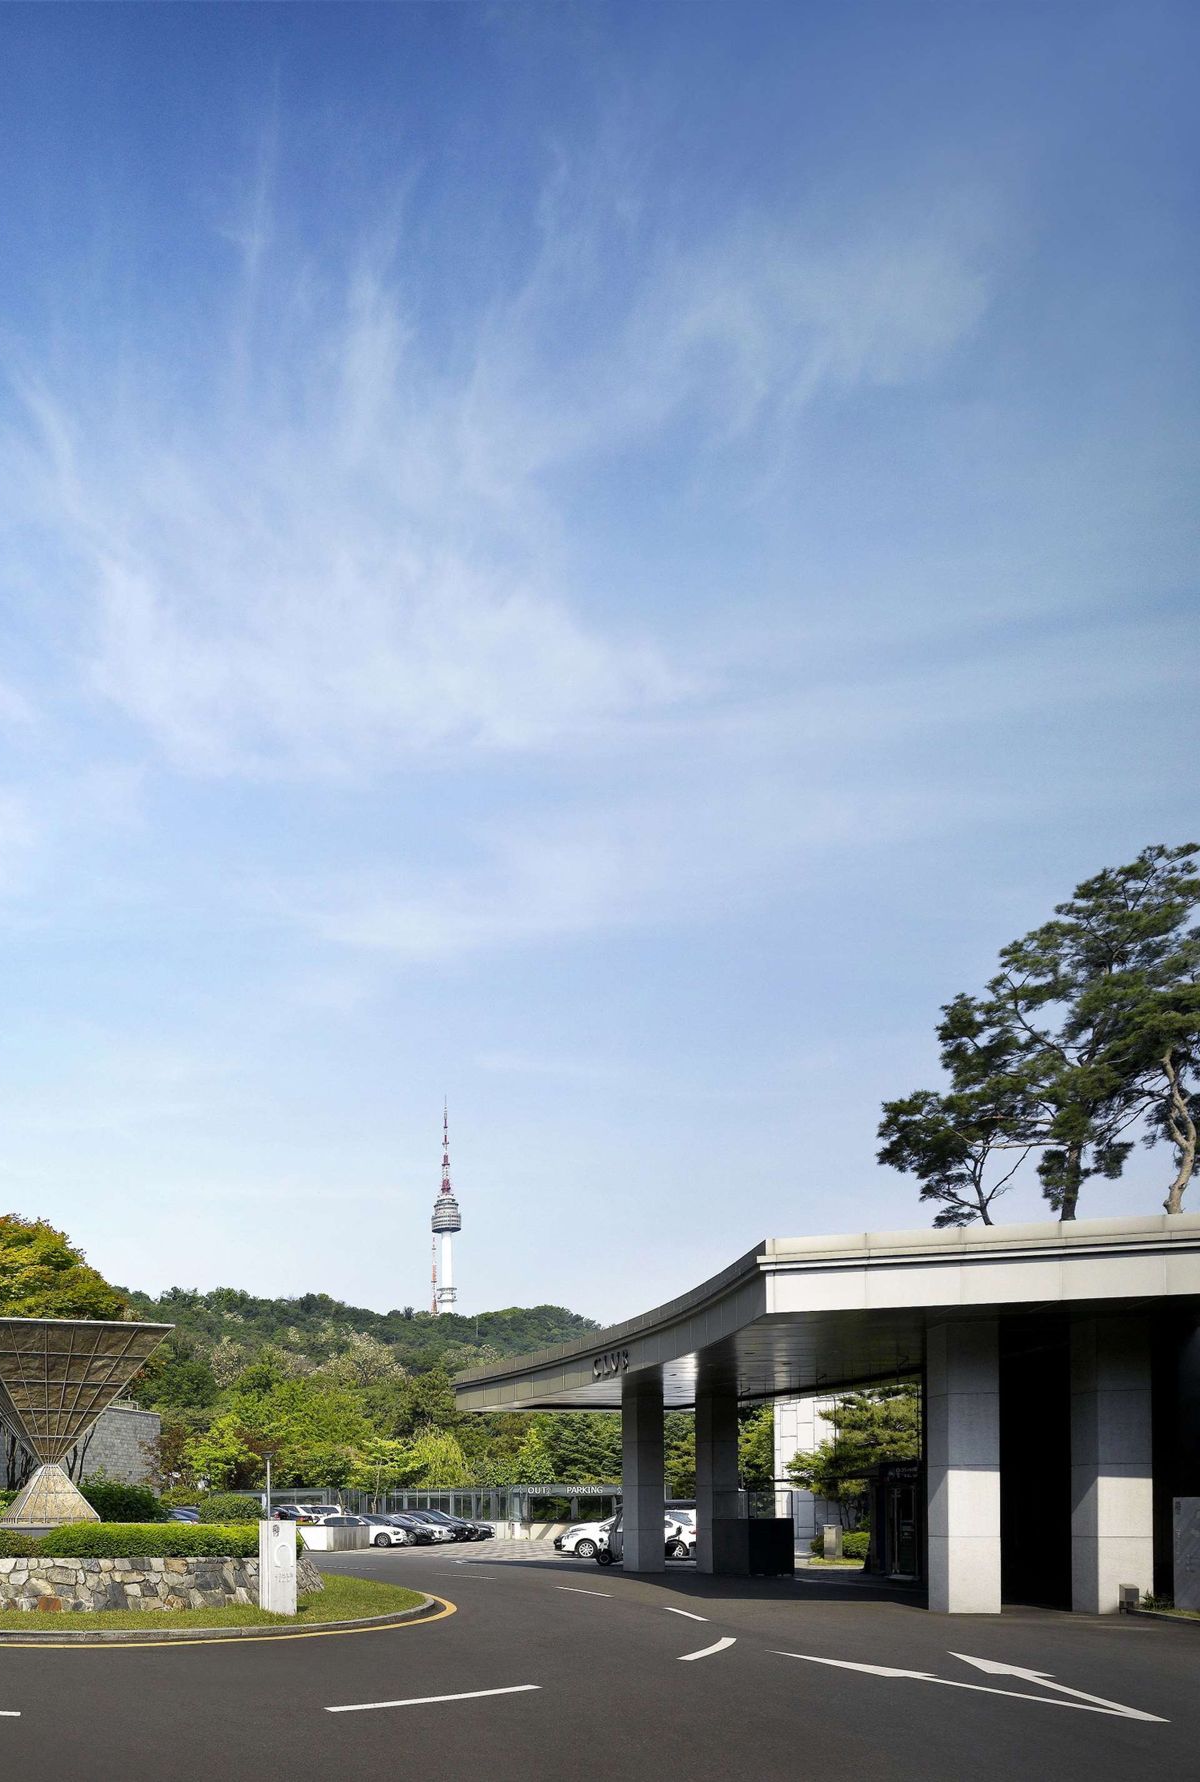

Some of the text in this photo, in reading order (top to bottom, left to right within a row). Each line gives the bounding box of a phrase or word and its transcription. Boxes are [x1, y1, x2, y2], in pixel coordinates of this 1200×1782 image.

[593, 1350, 629, 1377] CLUB
[527, 1486, 547, 1494] OUT
[566, 1486, 604, 1494] PARKING
